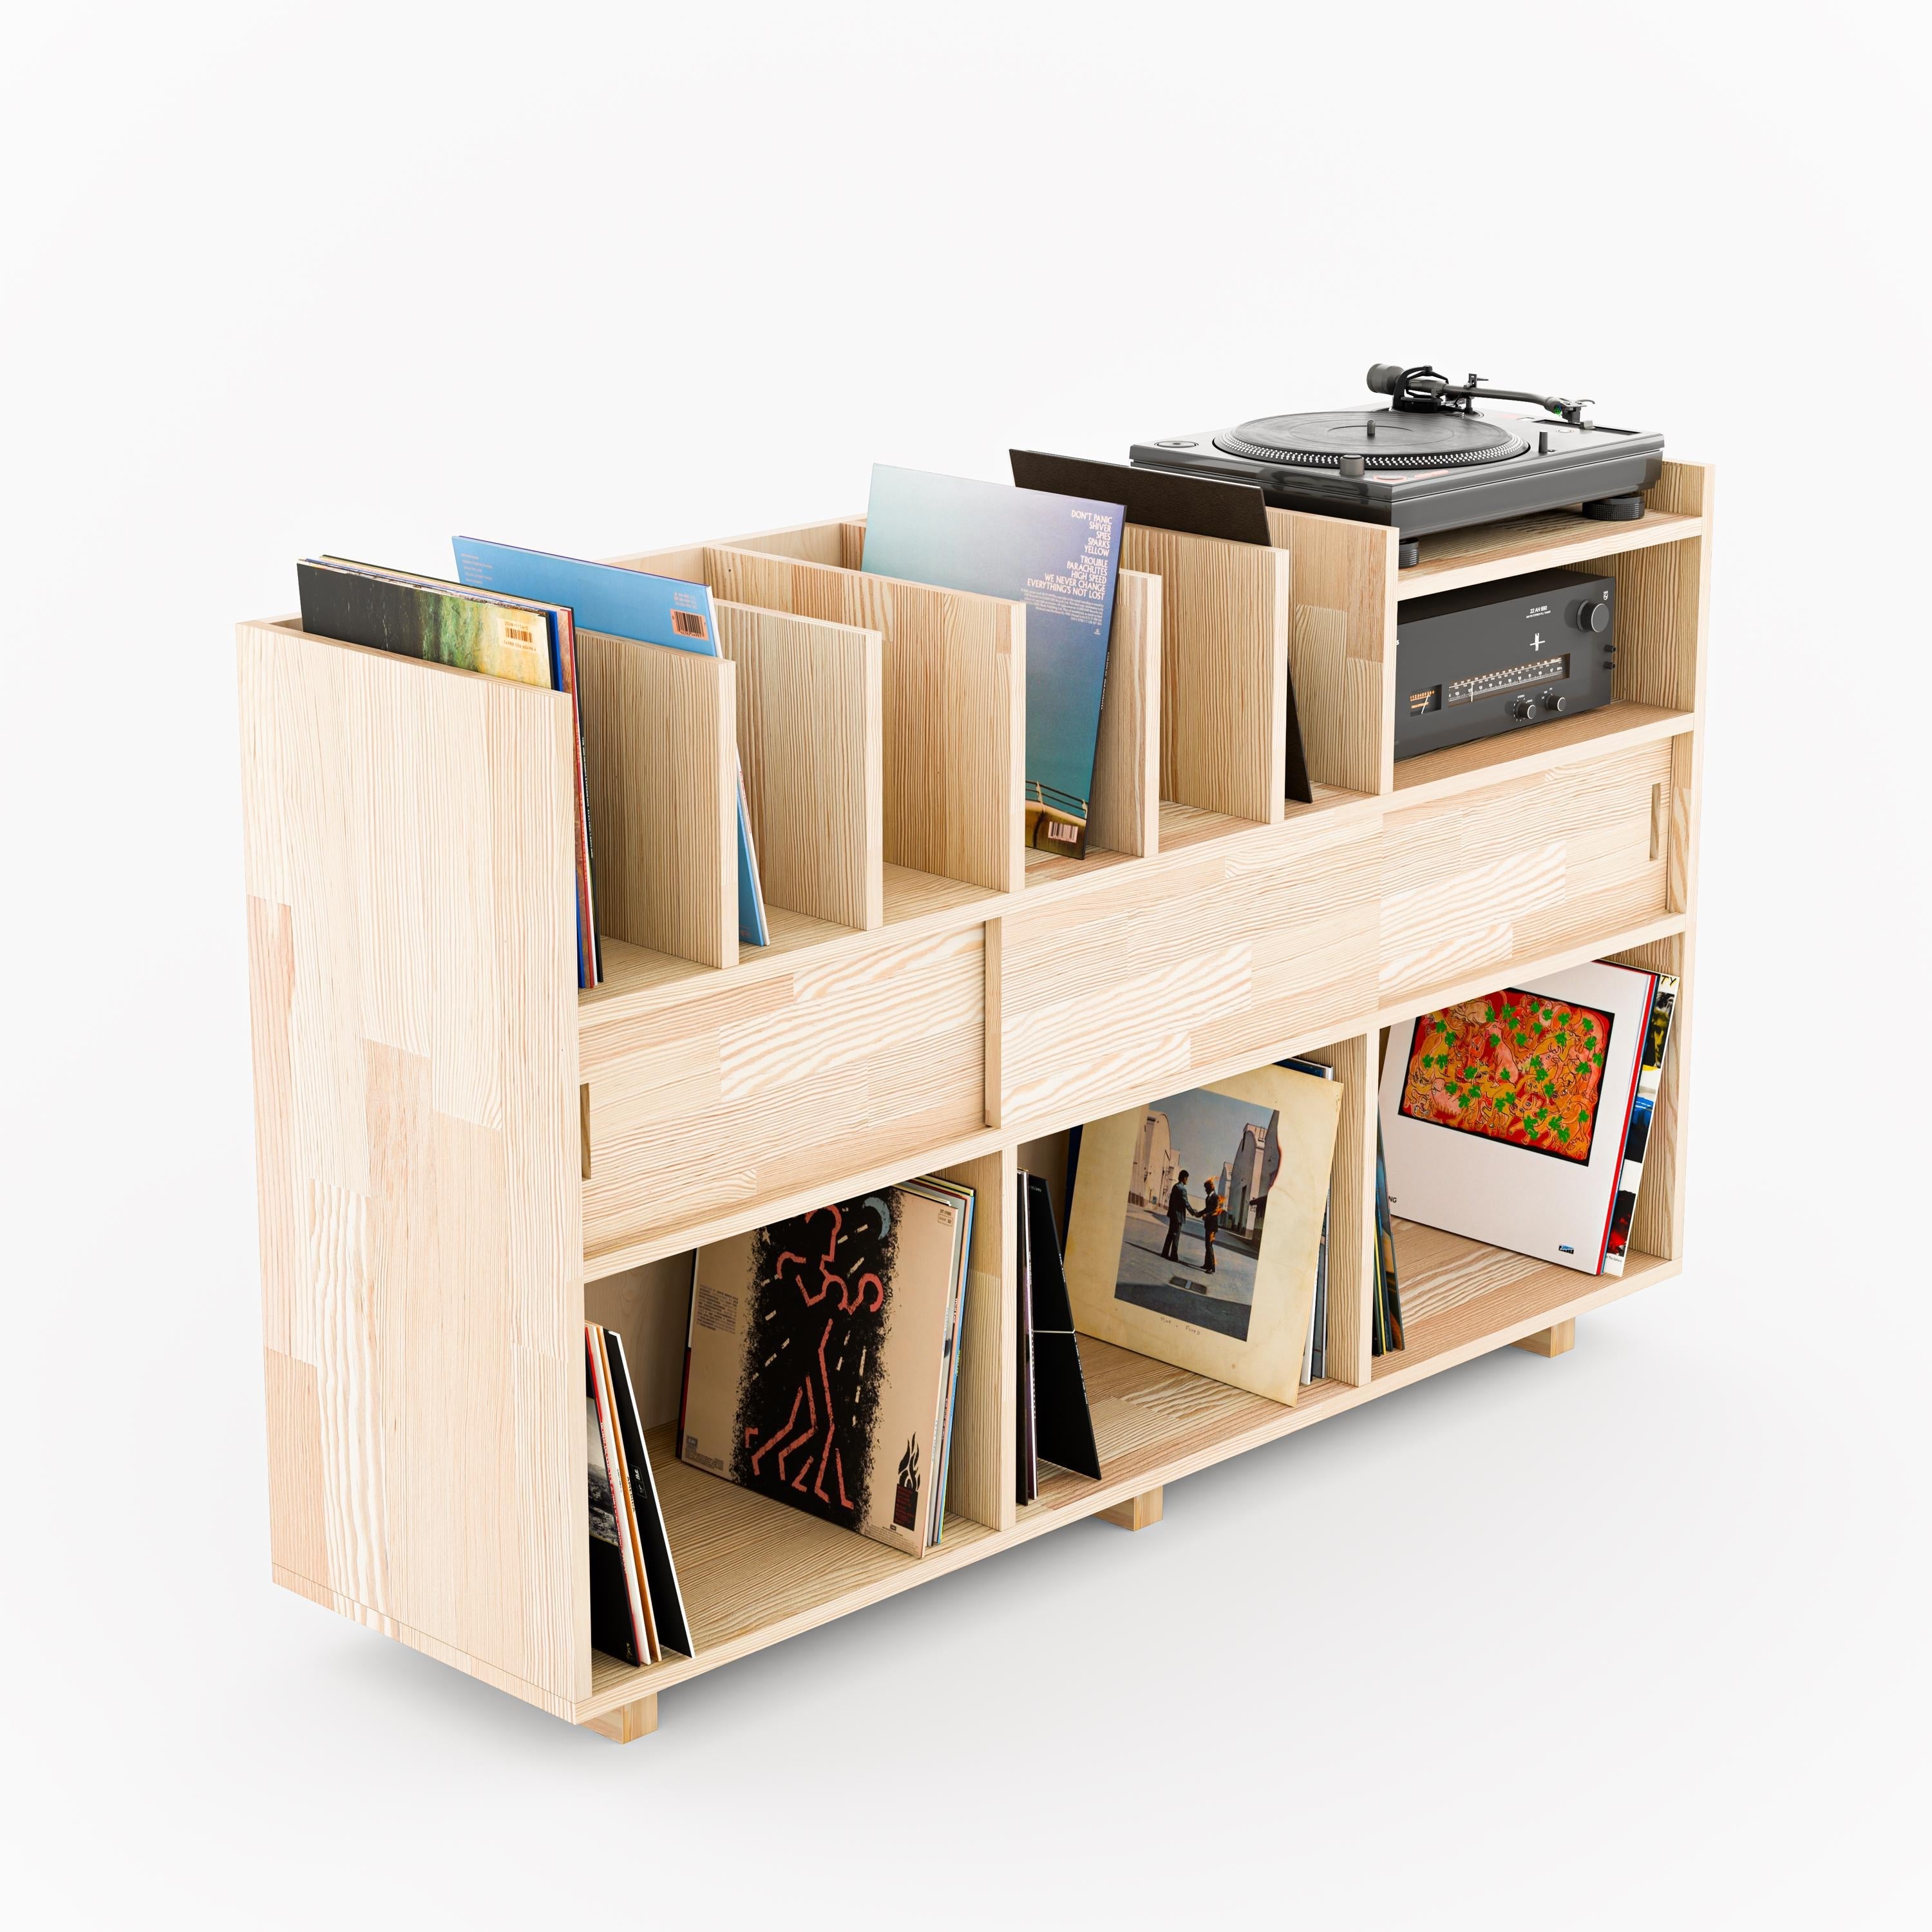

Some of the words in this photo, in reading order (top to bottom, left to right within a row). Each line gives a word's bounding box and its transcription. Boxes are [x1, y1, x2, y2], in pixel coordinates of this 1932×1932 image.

[1071, 509, 1092, 521] DON'T
[1094, 514, 1113, 525] PANIC
[1089, 521, 1112, 533] SHIVER
[1096, 531, 1111, 541] SPIES
[1088, 537, 1110, 549] SPARKS
[1084, 545, 1110, 557] YELLOW
[1081, 555, 1108, 568] TROUBLE
[1066, 561, 1108, 576] PARACHUTES
[1045, 573, 1055, 582] WE
[1056, 576, 1077, 587] NEVER
[1078, 580, 1106, 592] CHANGE
[1071, 570, 1087, 580] HIGH
[1088, 574, 1106, 584] SPEED
[1027, 578, 1071, 594] EVERYTHING'S
[1072, 587, 1087, 597] NOT
[1088, 591, 1105, 600] LOST
